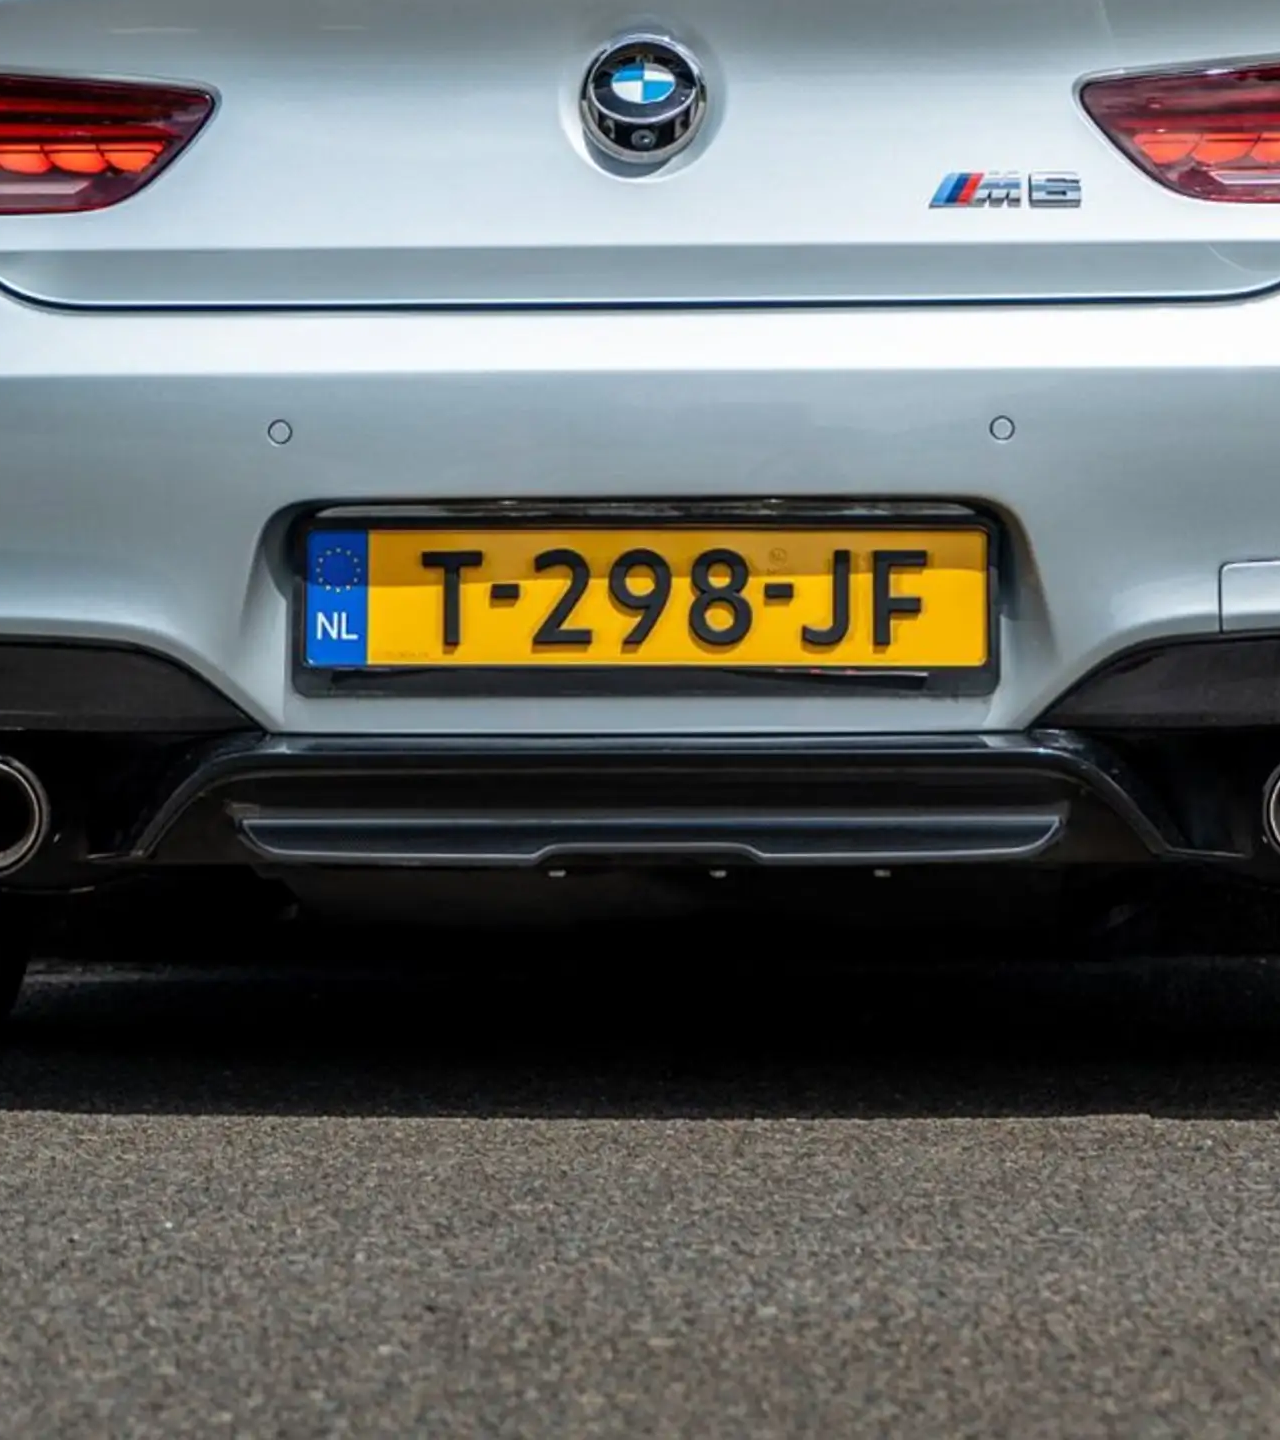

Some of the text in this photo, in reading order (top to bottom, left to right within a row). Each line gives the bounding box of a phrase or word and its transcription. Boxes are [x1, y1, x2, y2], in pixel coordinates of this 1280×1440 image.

[968, 169, 1082, 209] M6
[420, 547, 929, 648] T-298-JF
[316, 611, 359, 641] NL
